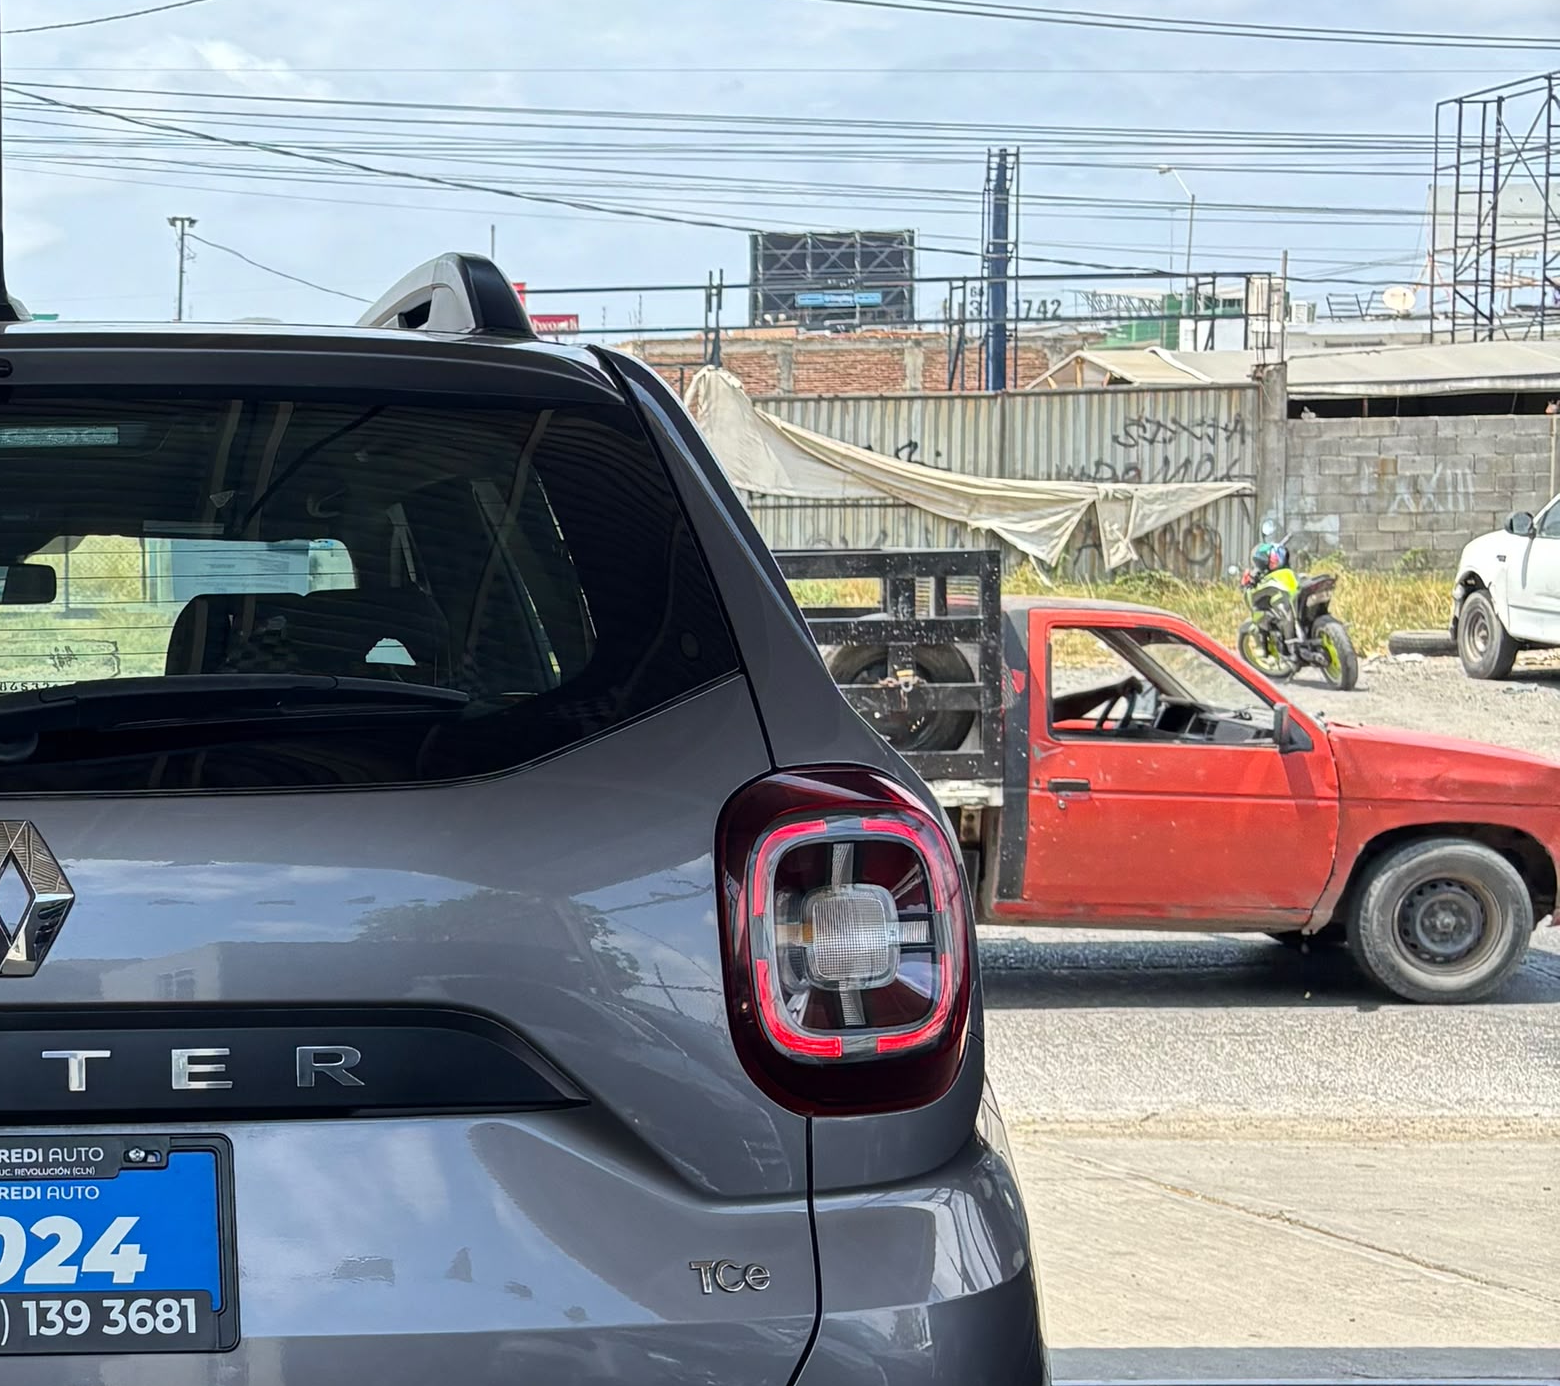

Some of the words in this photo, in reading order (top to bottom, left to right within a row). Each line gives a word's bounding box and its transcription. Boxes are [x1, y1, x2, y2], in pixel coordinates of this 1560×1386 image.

[48, 1147, 104, 1163] AUTO
[72, 1165, 96, 1176] (CLN)
[46, 1186, 100, 1200] AUTO
[689, 1259, 771, 1295] TCe
[22, 1299, 91, 1336] 139
[102, 1298, 197, 1335] 3681
